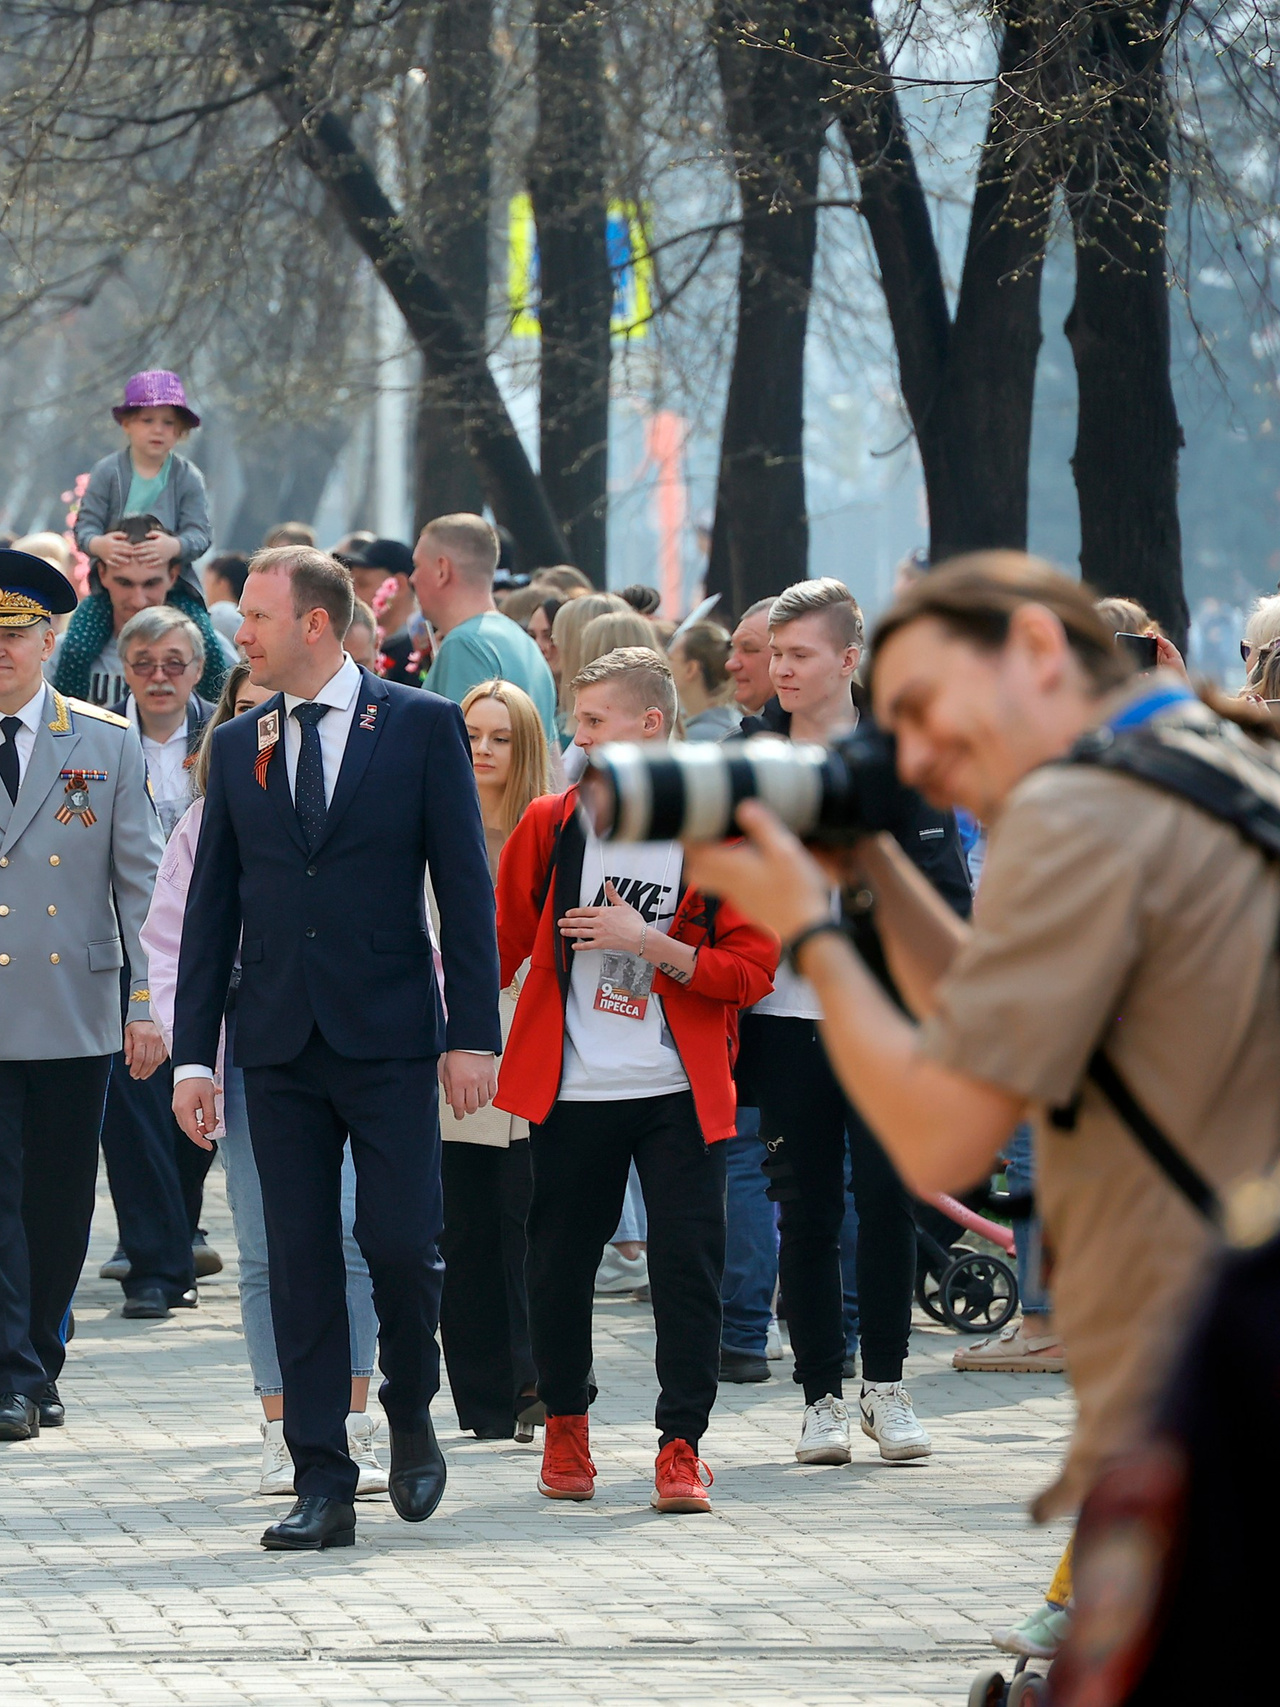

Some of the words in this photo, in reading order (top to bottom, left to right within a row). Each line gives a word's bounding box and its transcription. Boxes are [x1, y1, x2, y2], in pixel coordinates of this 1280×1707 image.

[601, 982, 613, 998] 9
[609, 992, 629, 1003] МАЯ
[599, 998, 640, 1017] ПРЕССА
